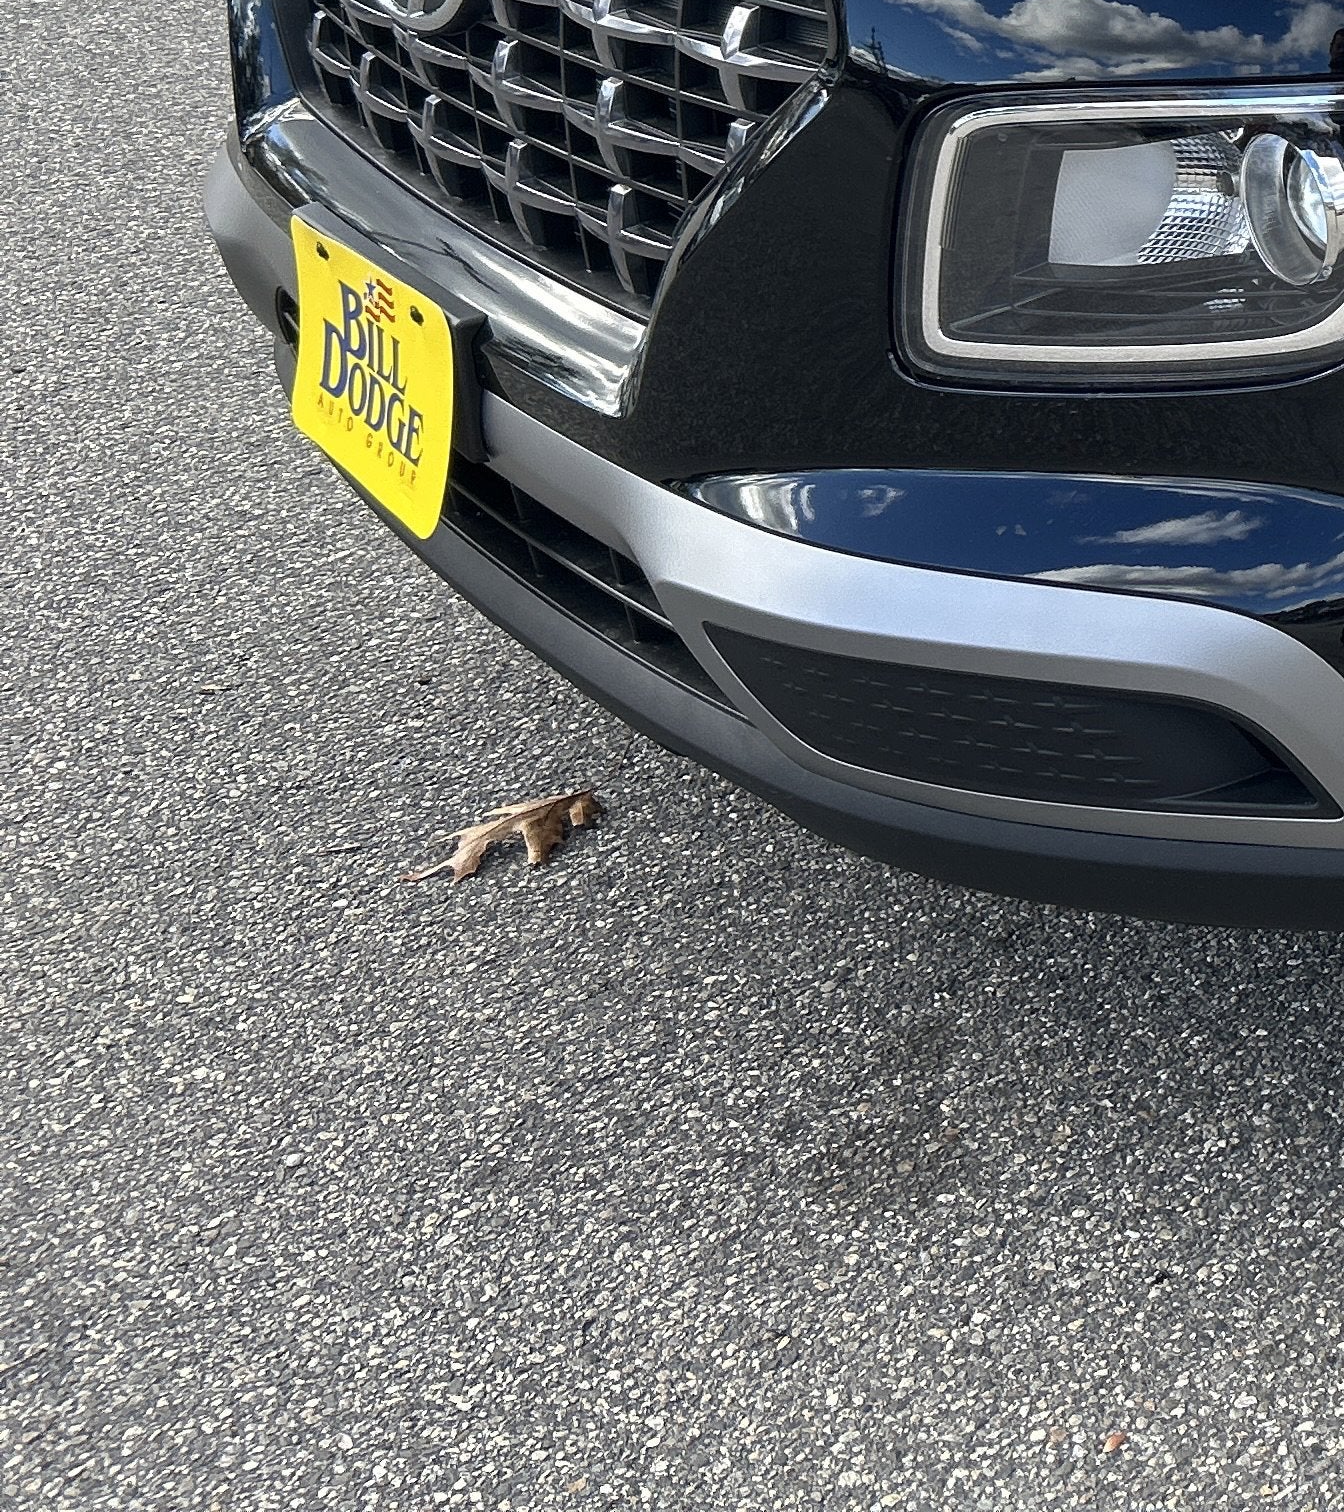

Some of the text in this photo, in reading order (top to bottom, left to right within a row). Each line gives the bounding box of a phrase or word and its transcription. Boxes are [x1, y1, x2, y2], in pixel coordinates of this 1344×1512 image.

[319, 318, 424, 466] DODGE
[338, 279, 407, 396] BILL
[317, 392, 417, 485] AUTO GROUP
